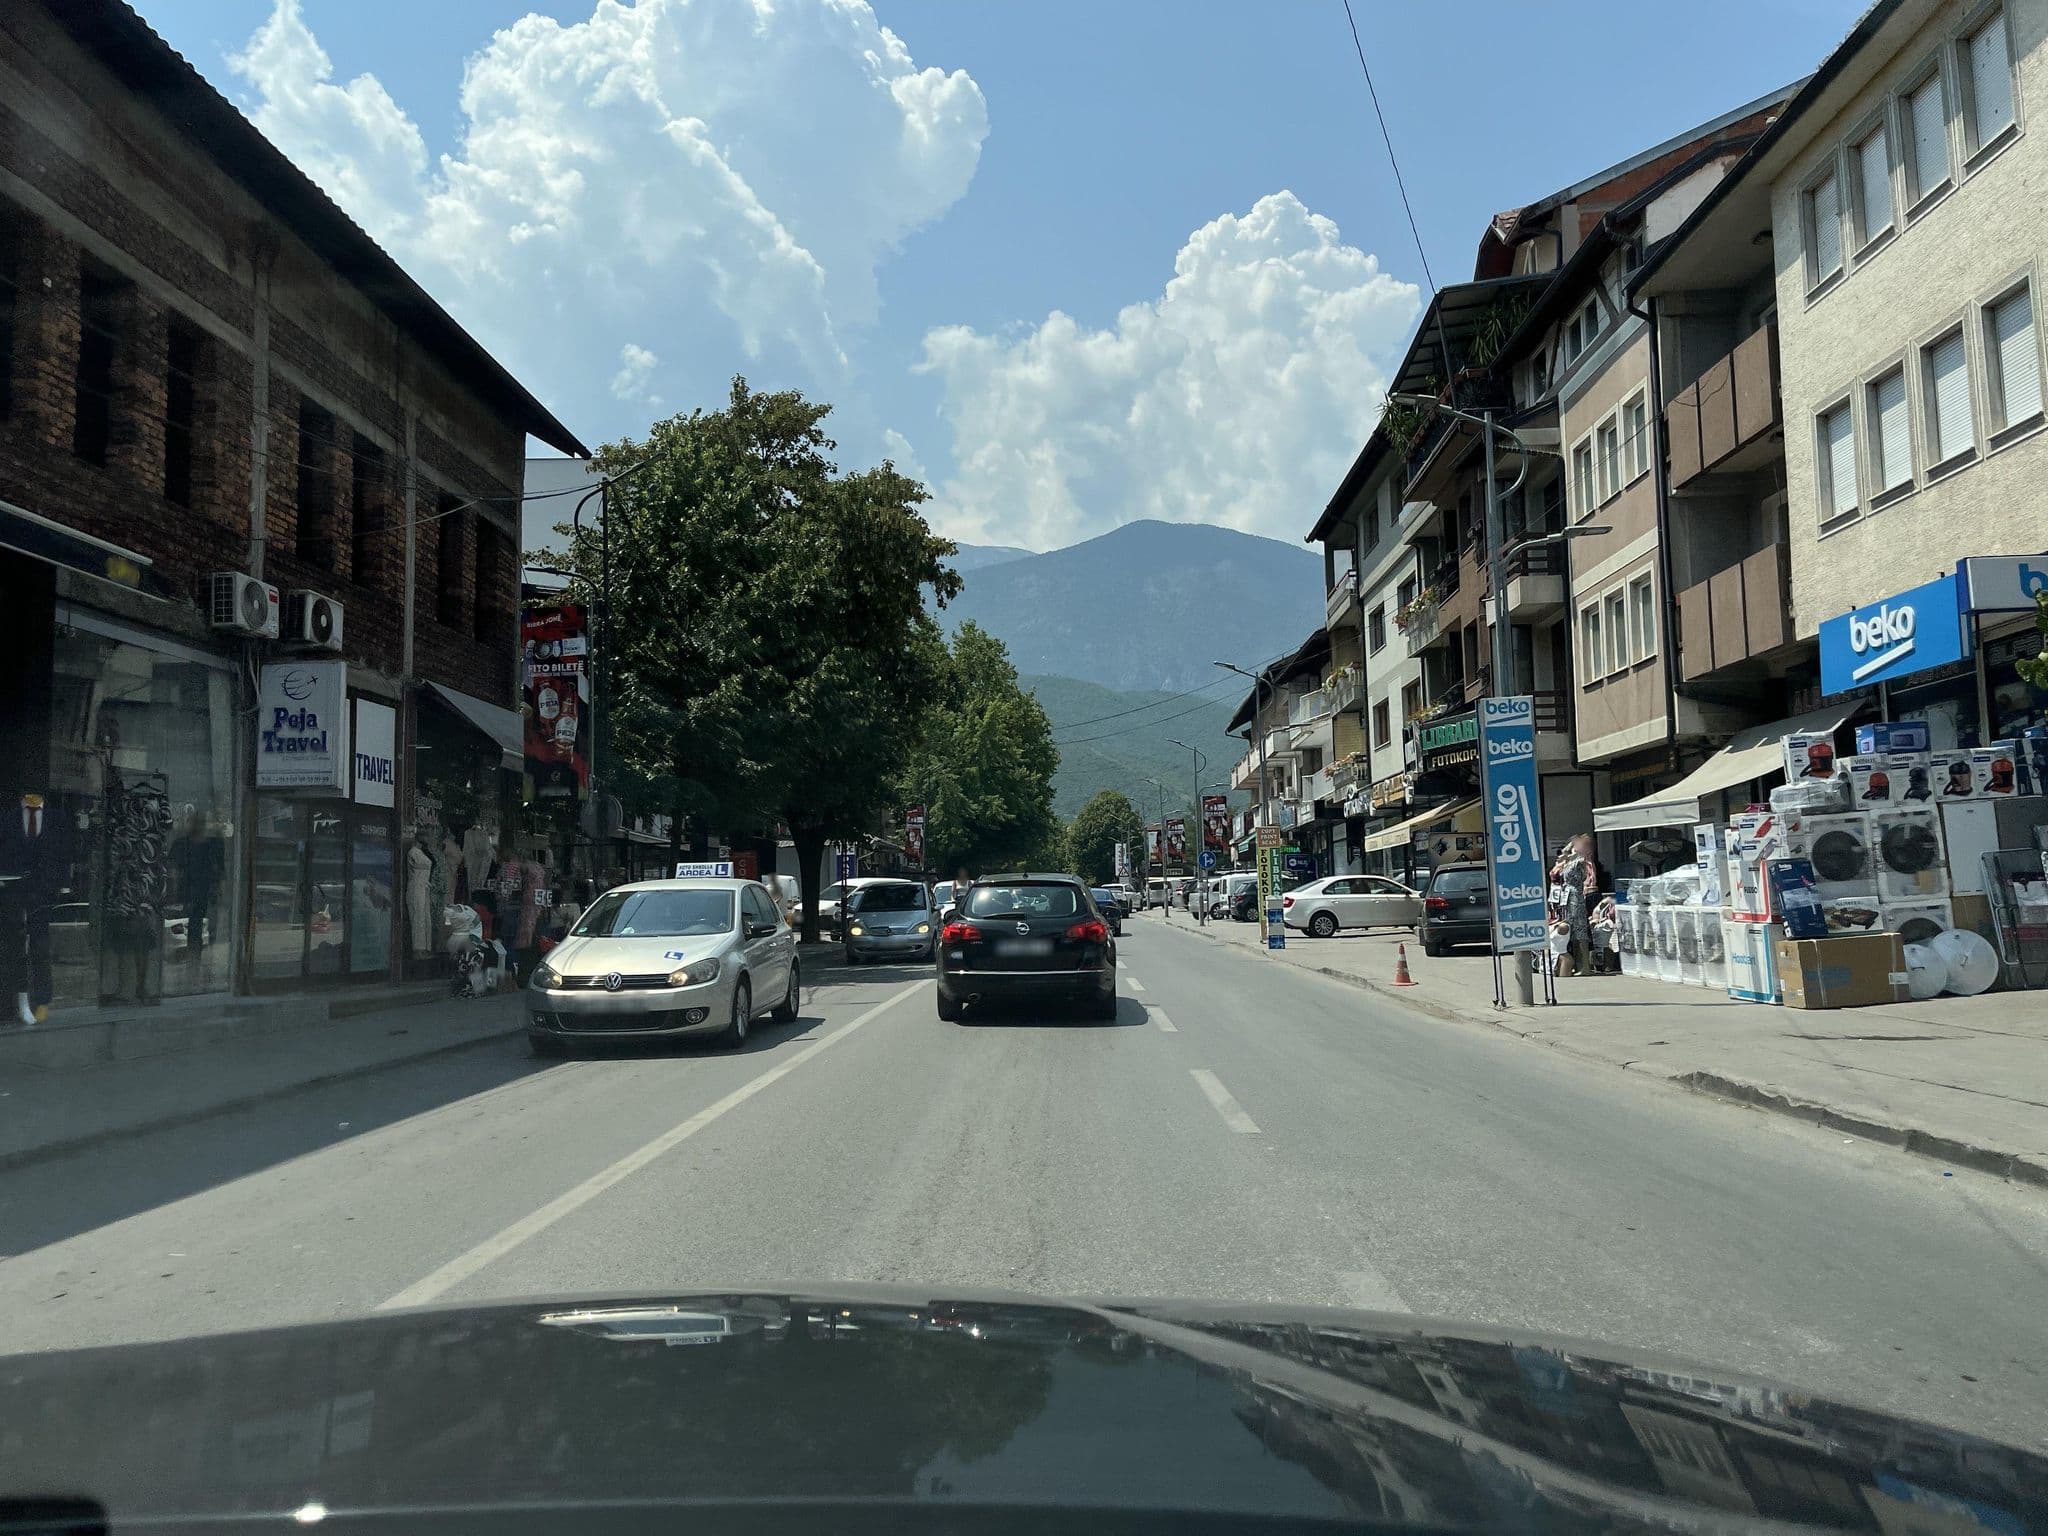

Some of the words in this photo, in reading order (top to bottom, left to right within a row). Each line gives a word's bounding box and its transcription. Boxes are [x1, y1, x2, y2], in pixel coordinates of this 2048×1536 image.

[1849, 604, 1915, 653] beko
[1486, 700, 1529, 715] beko
[273, 707, 319, 733] Peja
[262, 730, 328, 753] Travel
[1488, 739, 1533, 756] beko
[356, 752, 394, 785] TRAVEL
[1494, 784, 1522, 863] beko
[1499, 885, 1543, 900] beko
[1501, 923, 1545, 938] beko
